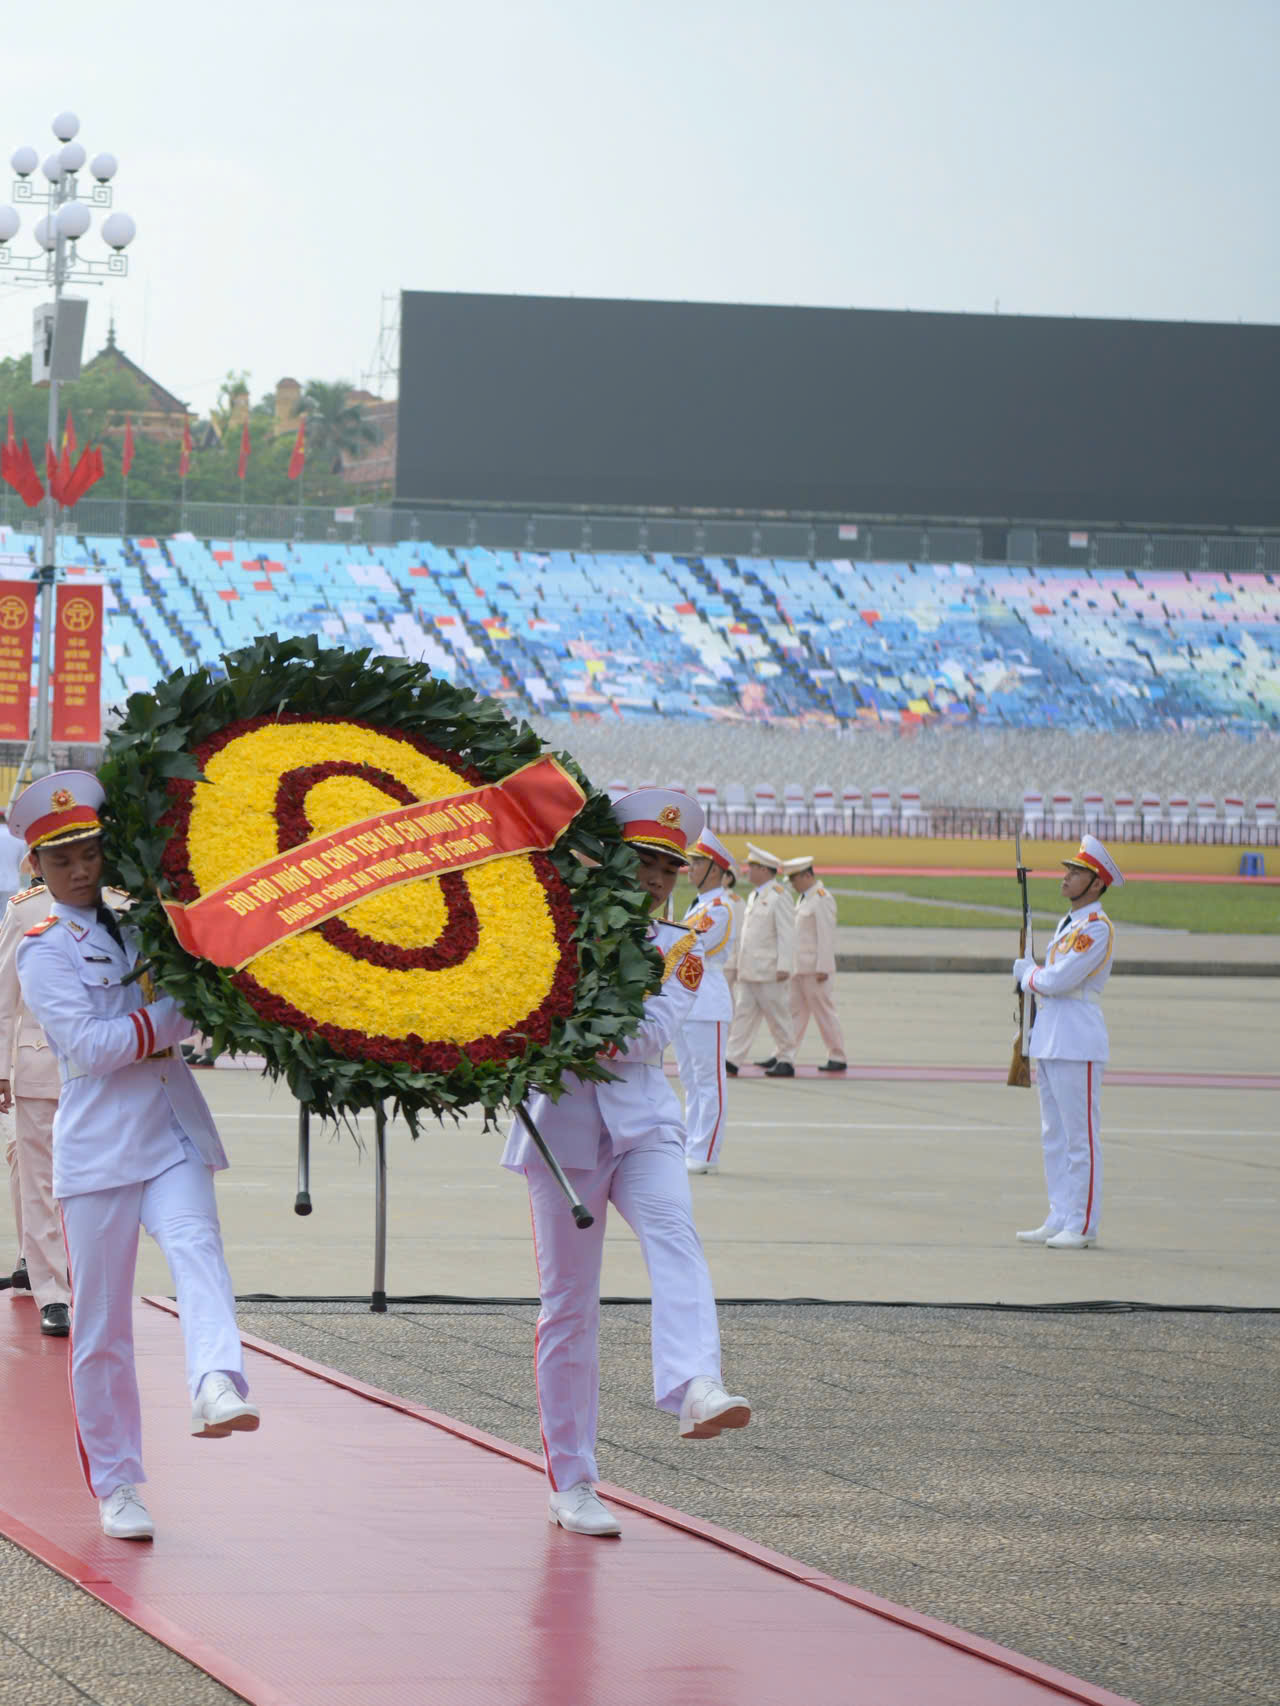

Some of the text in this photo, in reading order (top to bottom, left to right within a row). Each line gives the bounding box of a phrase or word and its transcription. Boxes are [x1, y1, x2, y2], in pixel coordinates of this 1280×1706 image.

[224, 802, 493, 916] ĐỜI ĐỜI NHỚ ƠN CHỦ TỊCH HỒ CHÍ MINH VĨ ĐẠI
[276, 903, 315, 925] ĐẢNG
[321, 879, 359, 900] CÔNG
[350, 871, 375, 888] AN
[364, 858, 406, 880] TRUNG
[430, 843, 454, 863] BỘ
[444, 840, 479, 857] CÔNG
[471, 832, 493, 848] AN
